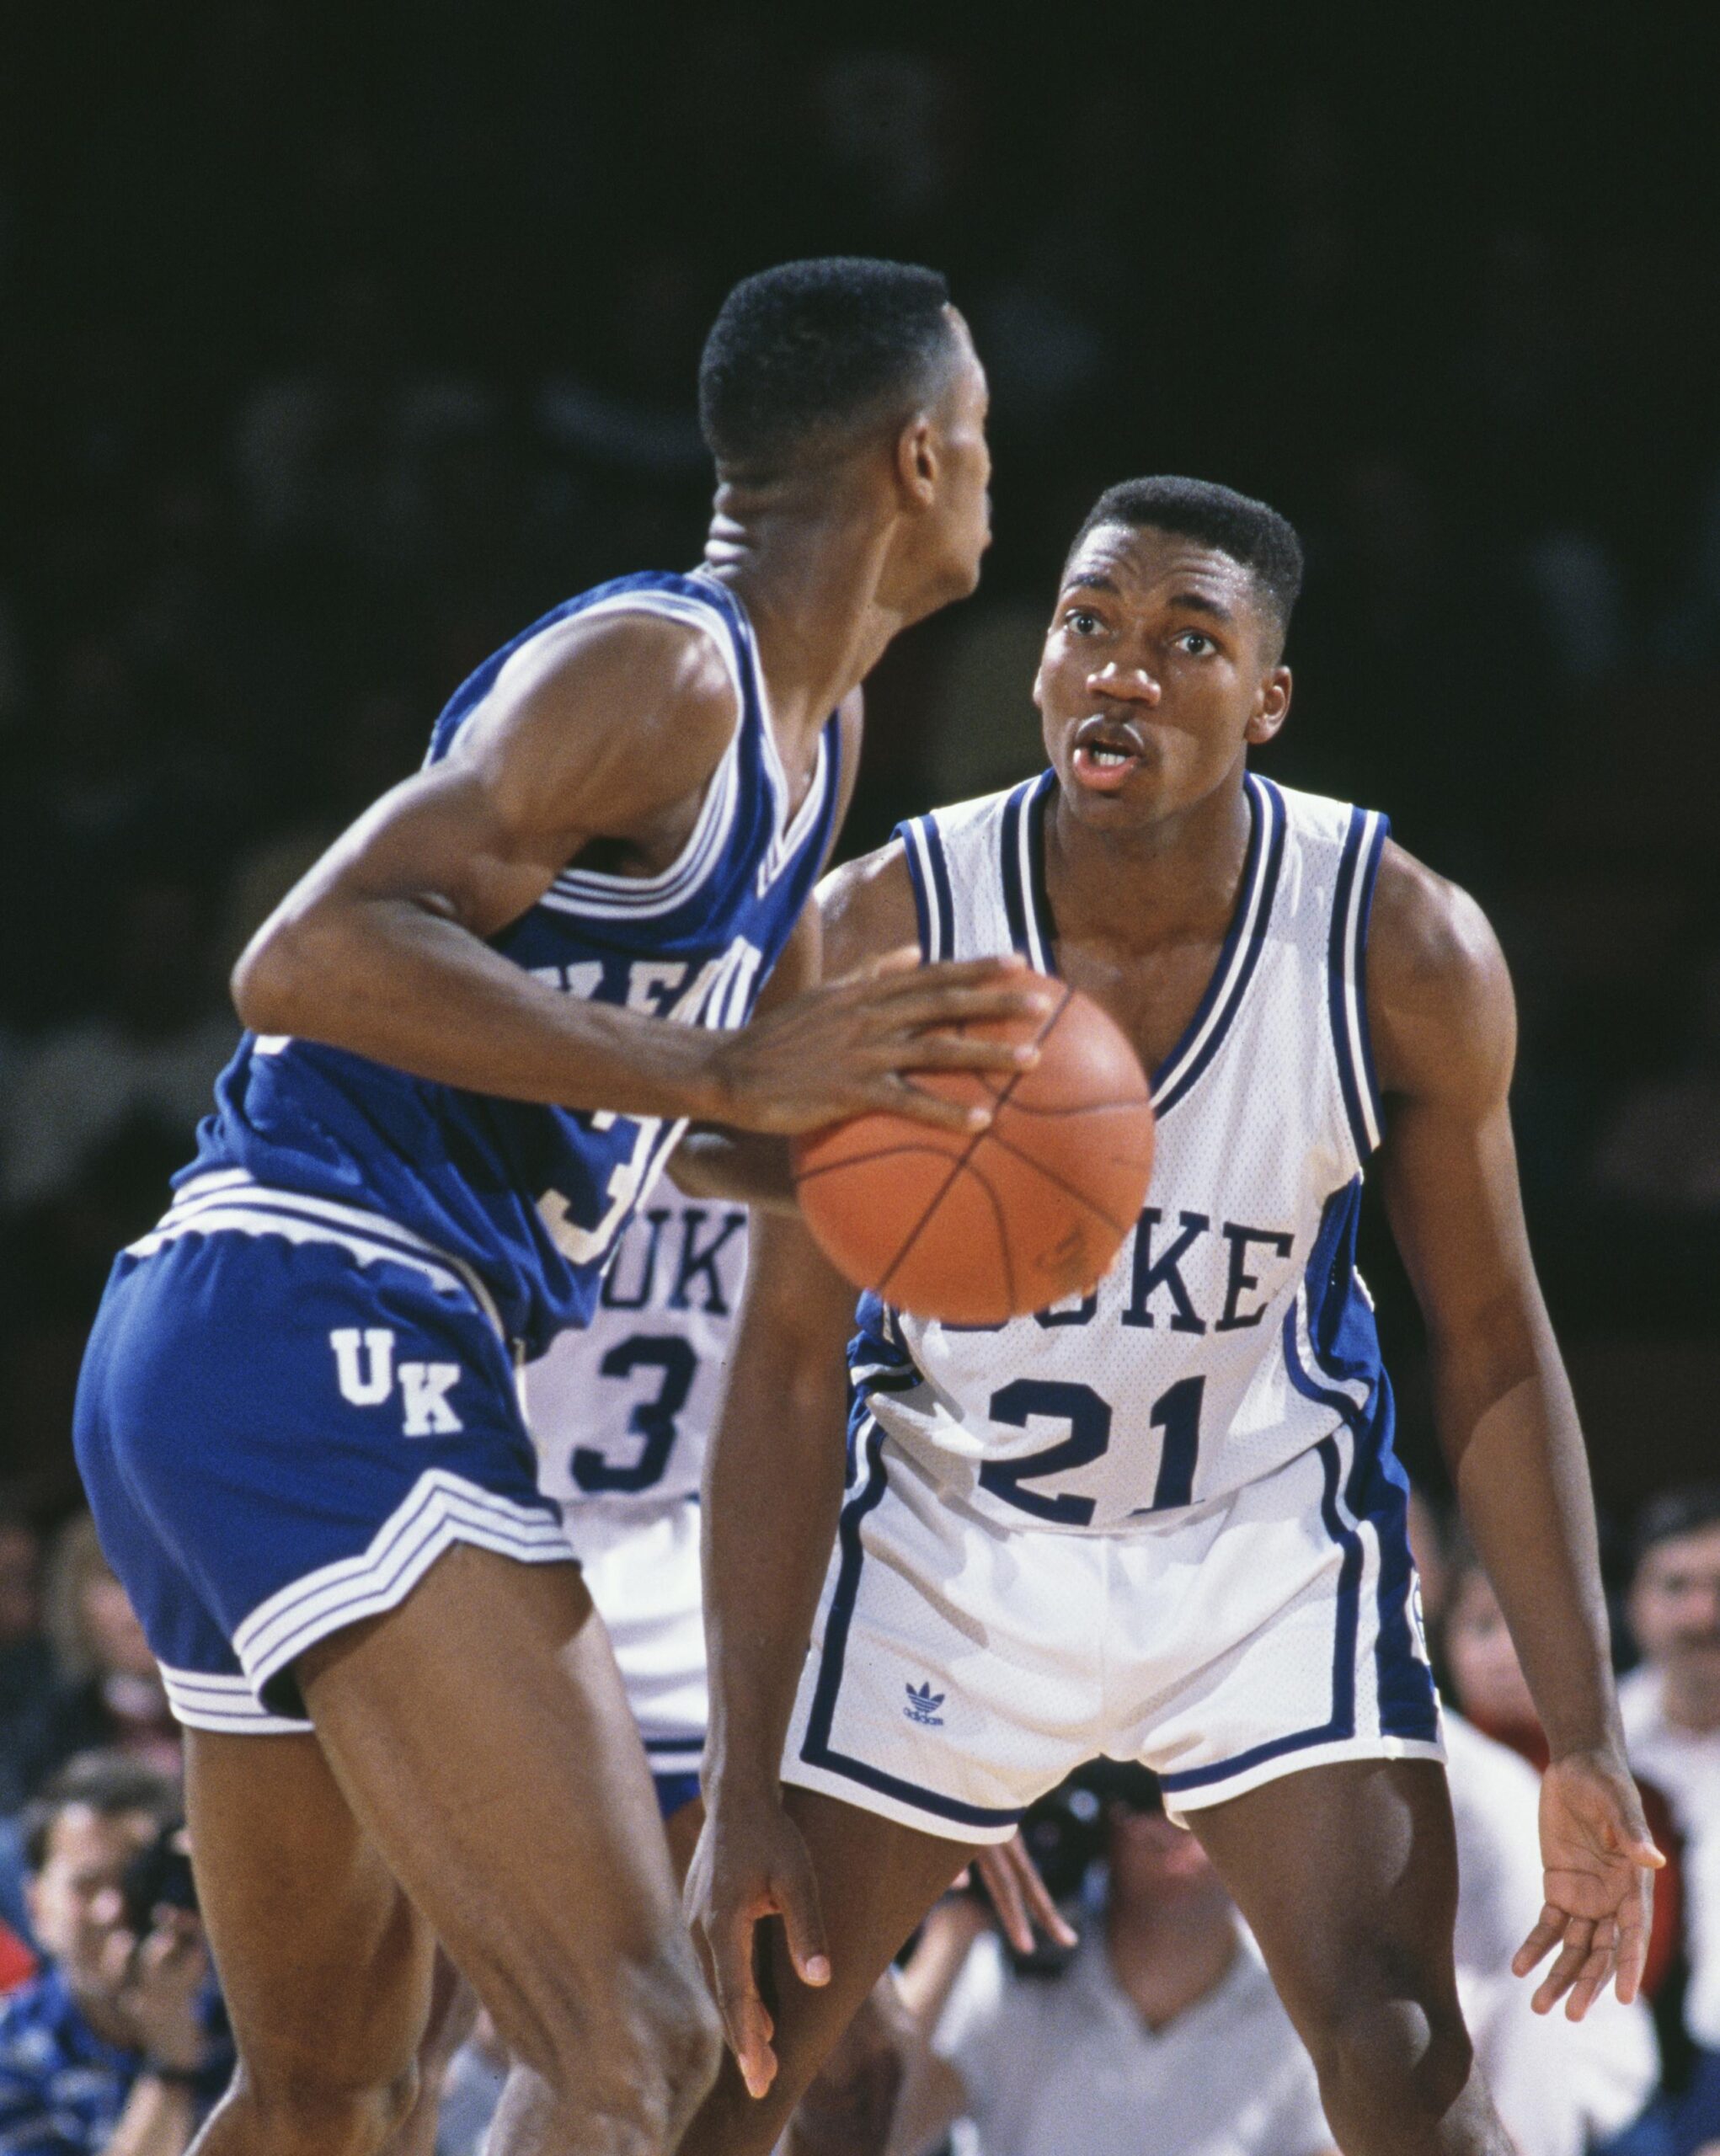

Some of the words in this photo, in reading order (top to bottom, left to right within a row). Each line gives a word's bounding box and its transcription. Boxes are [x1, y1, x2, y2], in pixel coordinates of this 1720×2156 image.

[537, 1110, 689, 1265] 3
[601, 1209, 746, 1315] UK
[941, 1208, 1295, 1335] KE
[329, 1327, 463, 1437] UK
[569, 1335, 702, 1504] 3
[979, 1375, 1205, 1527] 21
